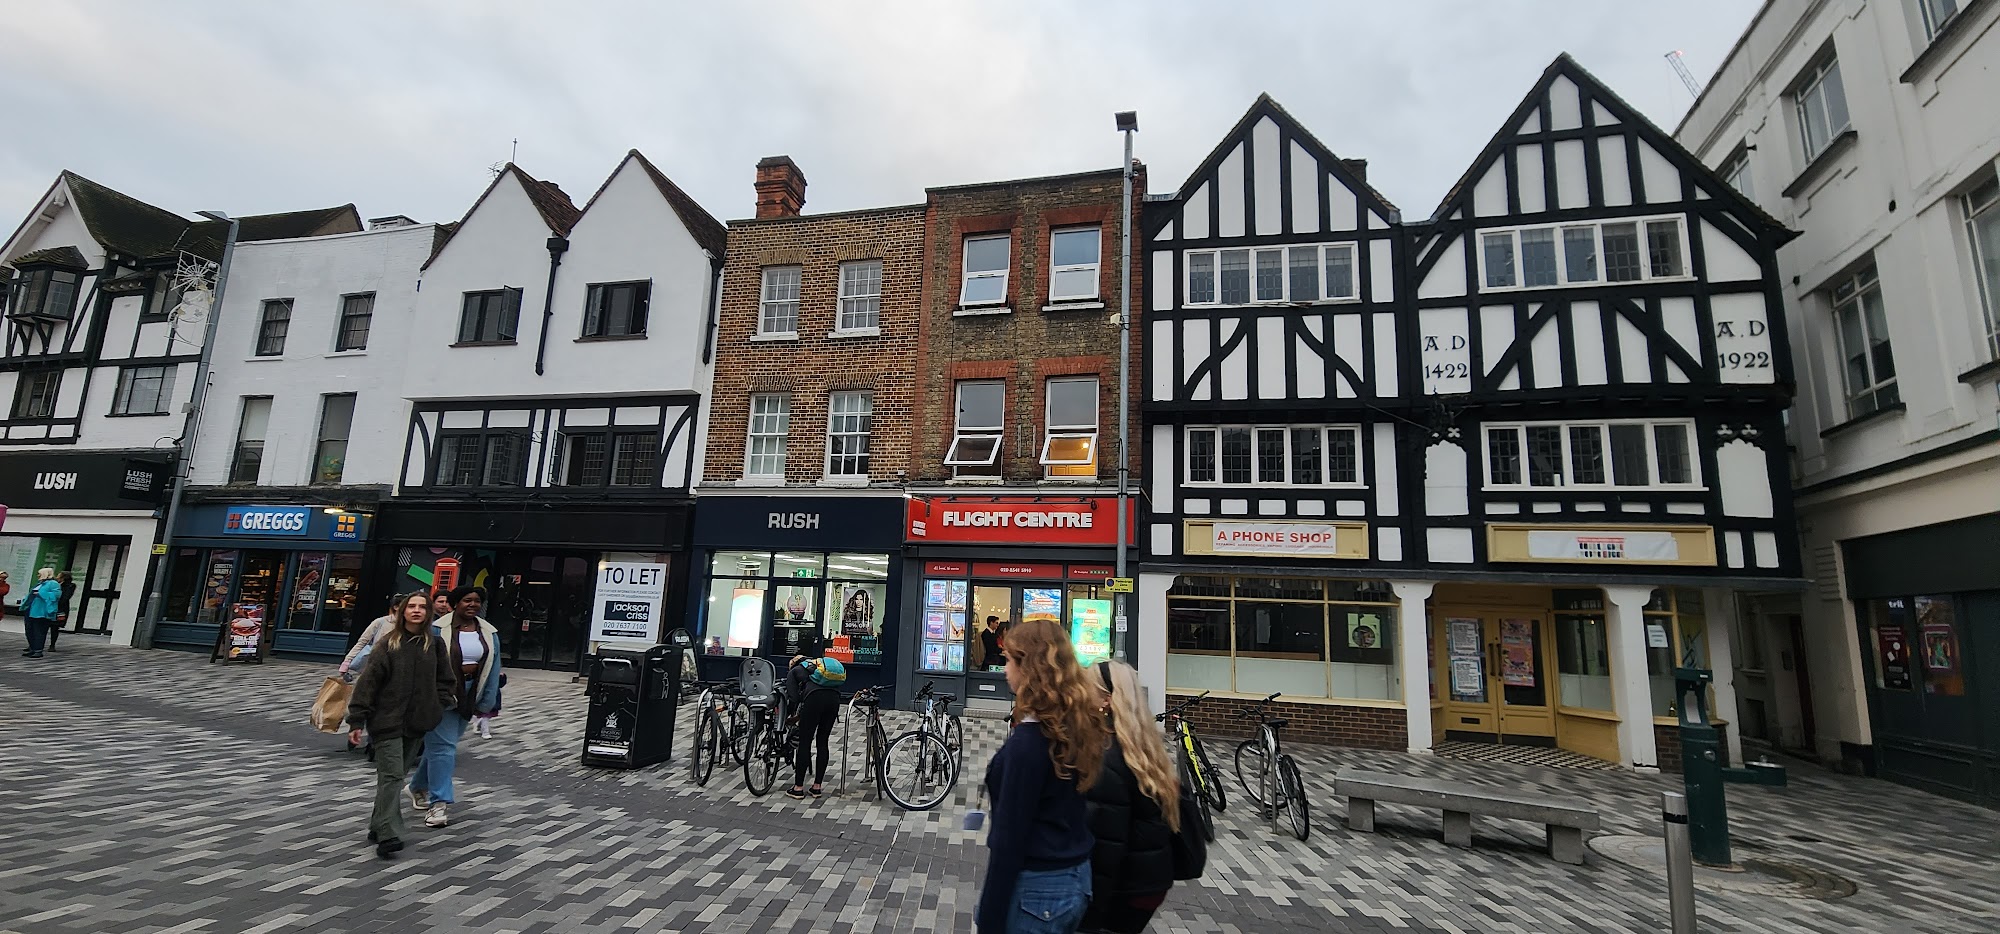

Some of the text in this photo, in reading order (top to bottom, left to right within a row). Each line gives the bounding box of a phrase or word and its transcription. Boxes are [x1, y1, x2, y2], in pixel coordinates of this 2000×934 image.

[1719, 351, 1769, 370] 1922
[1425, 362, 1468, 379] 1422
[33, 472, 78, 490] LUSH
[125, 475, 152, 485] FRESH
[126, 469, 153, 479] LUSH
[241, 511, 305, 531] GREGGS
[767, 512, 820, 530] RUSH
[942, 511, 1012, 528] FLIGHT
[1013, 511, 1093, 529] CENTRE
[333, 531, 356, 539] GREGGS
[1217, 530, 1332, 544] A PHONE SHOP
[604, 567, 661, 586] TO LET
[612, 602, 649, 613] jackson
[626, 611, 648, 620] criss
[603, 621, 647, 632] 020 7637 7100
